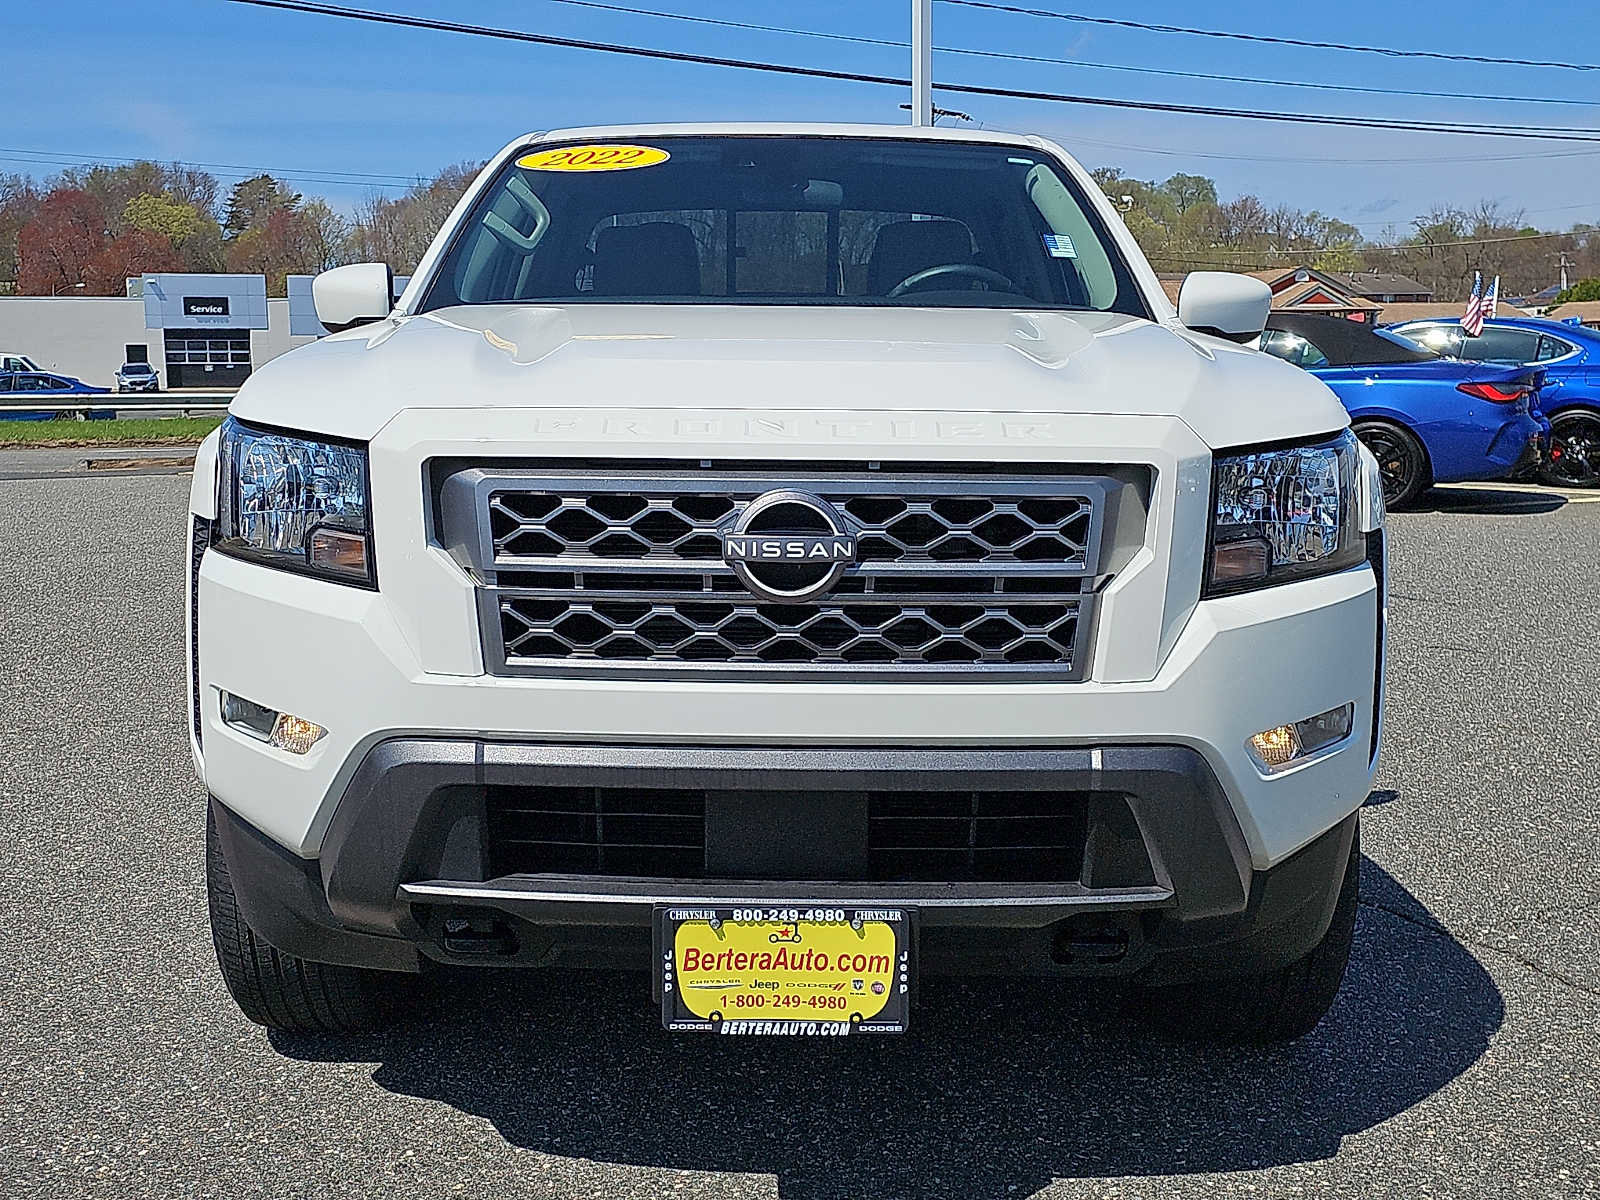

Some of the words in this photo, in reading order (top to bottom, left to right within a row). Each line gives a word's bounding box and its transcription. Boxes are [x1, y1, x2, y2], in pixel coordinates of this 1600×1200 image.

[540, 150, 645, 166] 2022
[190, 305, 223, 313] Service
[533, 415, 1056, 440] FRONTIER
[727, 541, 852, 558] NISSAN
[669, 910, 716, 920] CHRYSLER
[732, 909, 846, 922] 800-249-4980
[854, 910, 903, 921] CHRYSLER
[683, 947, 890, 973] BerteraAuto.com
[664, 950, 673, 993] Jeep
[899, 951, 908, 994] Jeep
[749, 979, 780, 991] Jeep
[720, 994, 847, 1010] 1-800-249-4980
[720, 1021, 851, 1036] BERTERAAUTO.COM
